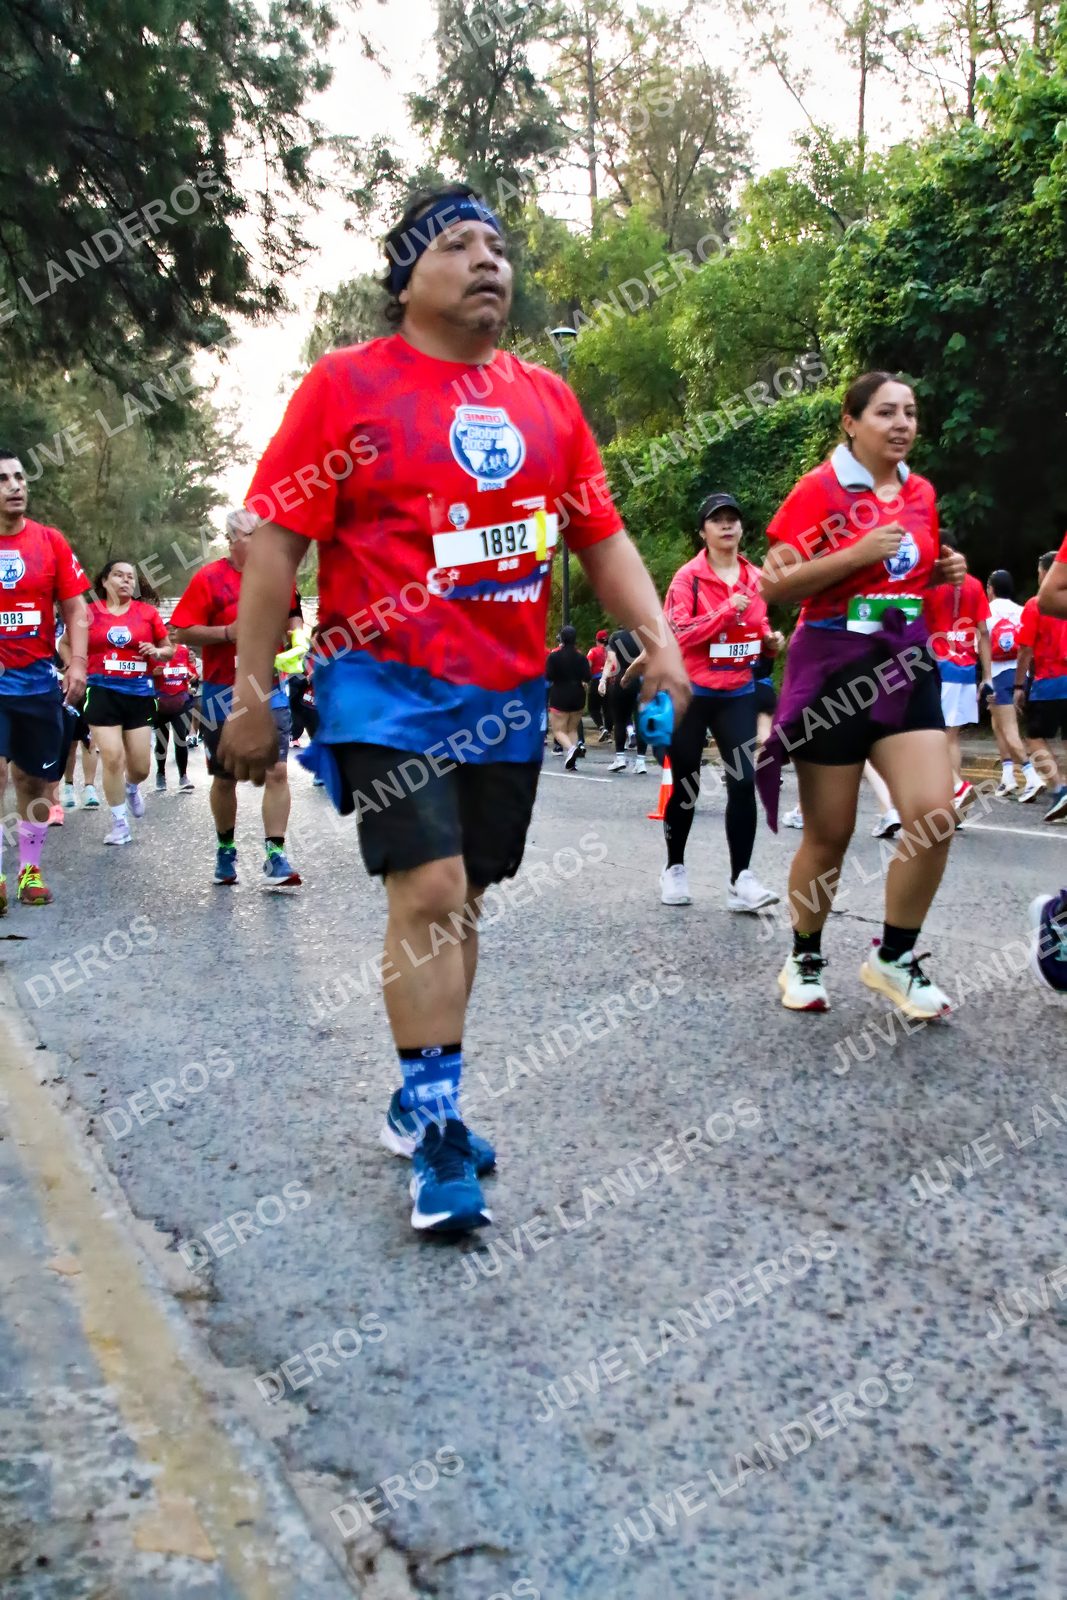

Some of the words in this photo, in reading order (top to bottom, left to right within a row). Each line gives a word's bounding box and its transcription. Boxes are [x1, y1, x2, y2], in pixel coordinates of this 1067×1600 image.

[464, 413, 501, 423] BIMBO
[480, 523, 528, 558] 1892
[729, 643, 749, 656] 1832
[119, 661, 136, 671] 1543
